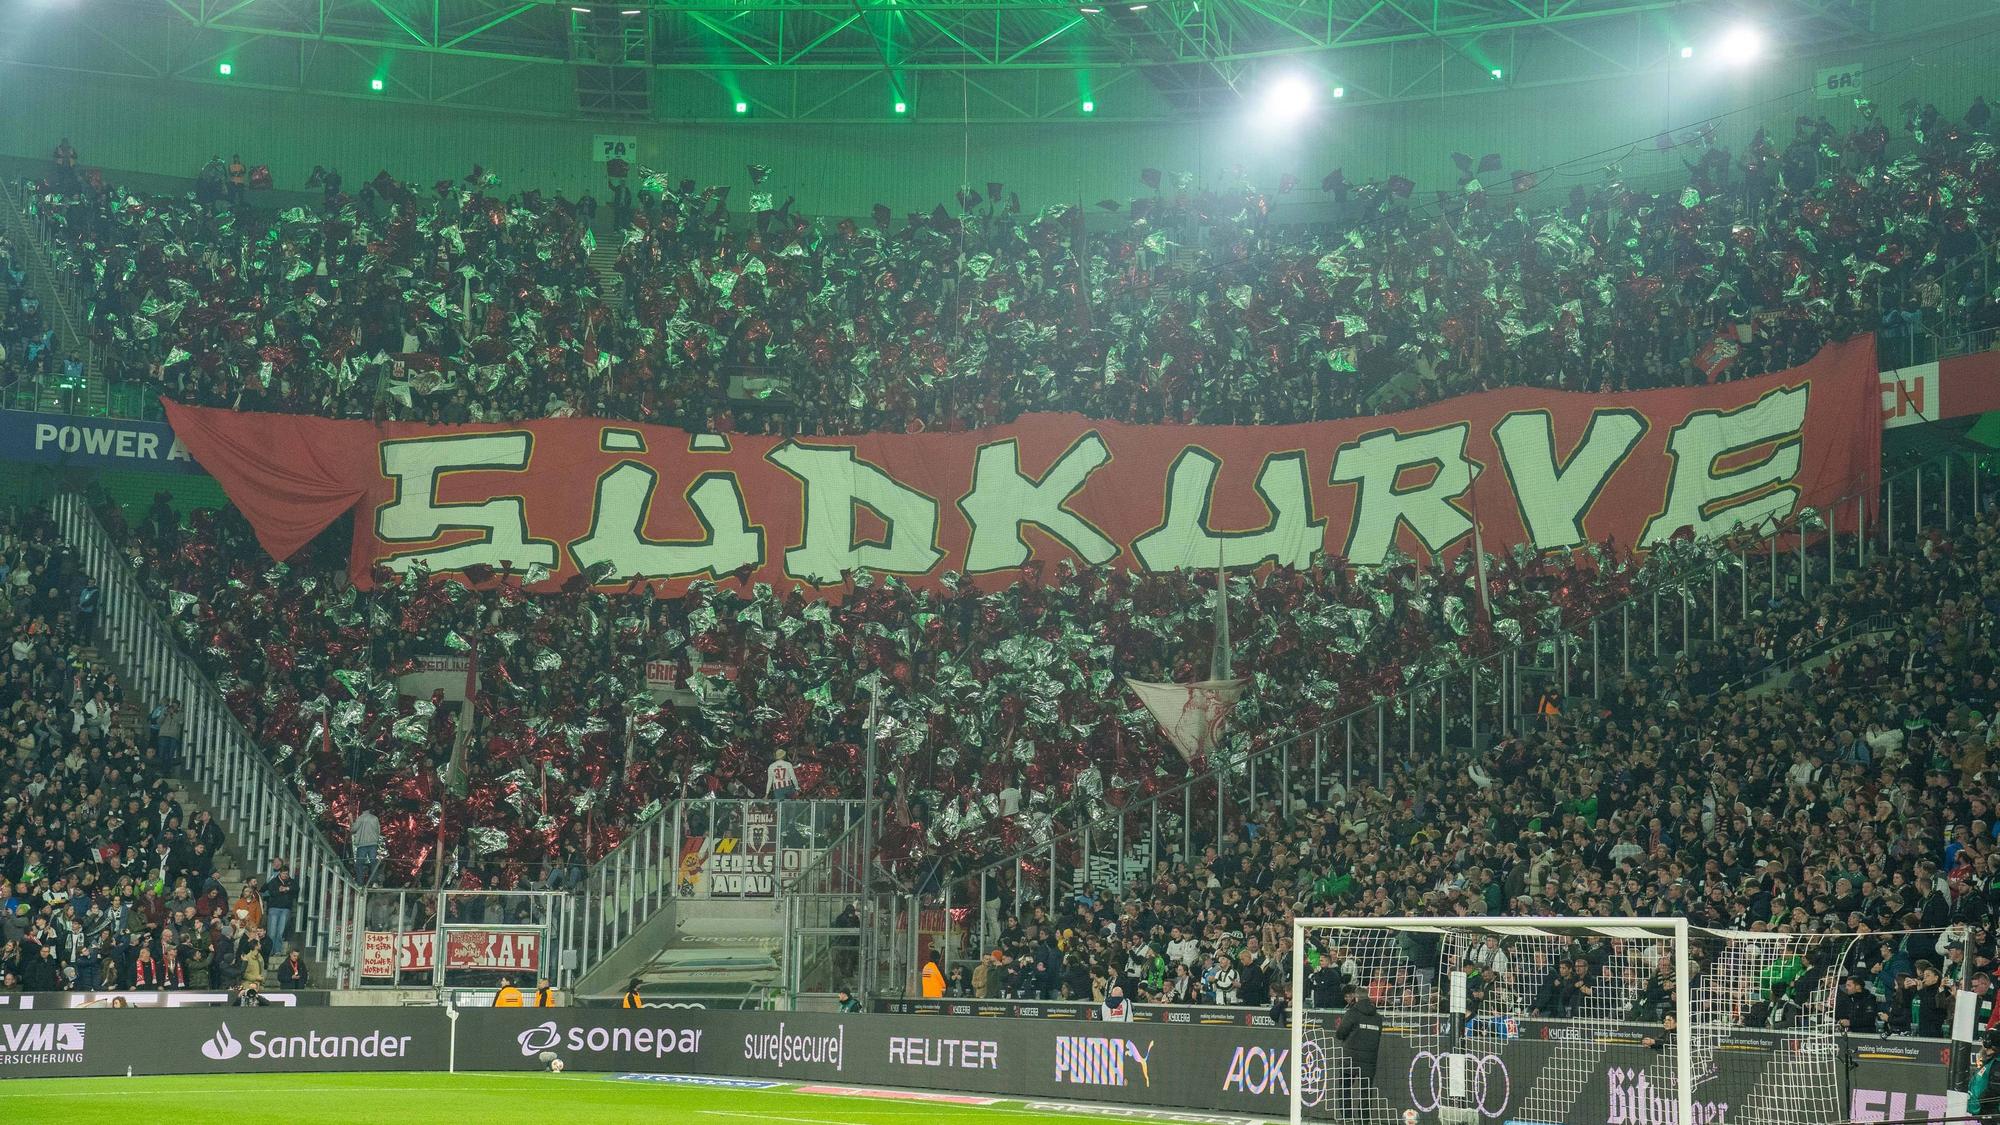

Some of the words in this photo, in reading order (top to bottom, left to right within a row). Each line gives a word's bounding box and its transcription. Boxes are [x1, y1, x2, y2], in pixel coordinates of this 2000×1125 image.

[603, 141, 626, 156] 7A
[34, 422, 159, 461] POWER
[375, 380, 1812, 587] SÜDKURVE
[248, 1029, 412, 1059] Santander
[567, 1022, 703, 1061] sonepar
[744, 1022, 843, 1072] sure[secure]
[889, 1037, 998, 1069] REUTER
[1055, 1036, 1124, 1086] PUMA
[1857, 1045, 1875, 1054] making
[1875, 1046, 1904, 1055] information
[1222, 1046, 1290, 1096] AOK
